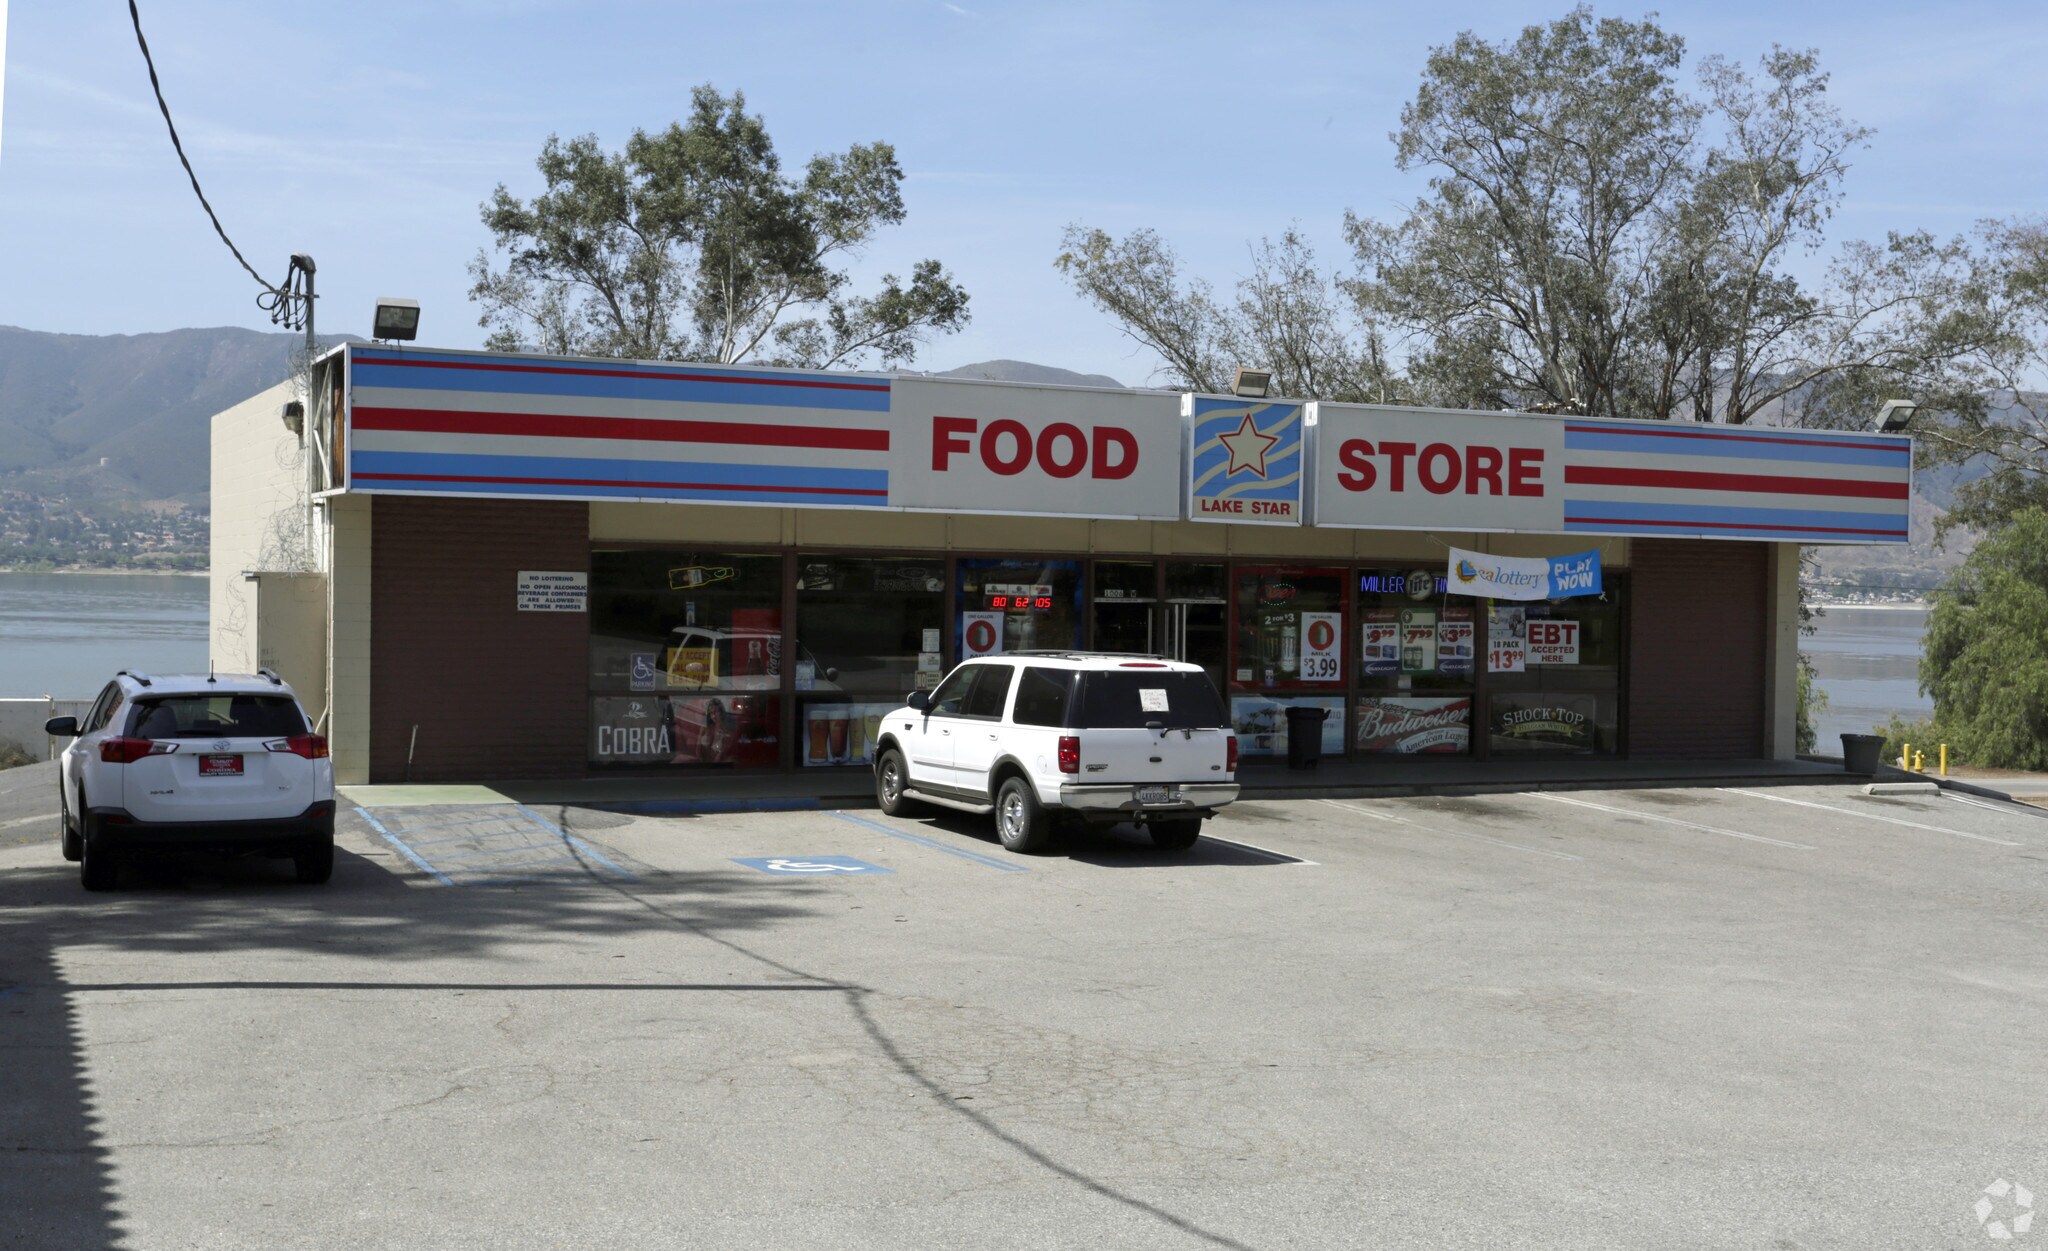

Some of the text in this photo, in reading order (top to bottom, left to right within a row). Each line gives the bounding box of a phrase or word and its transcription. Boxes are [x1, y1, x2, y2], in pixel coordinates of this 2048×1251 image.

[932, 417, 1139, 480] FOOD
[1337, 438, 1544, 497] STORE
[1201, 498, 1291, 516] LAKE STAR
[1553, 556, 1593, 577] PLAY
[1360, 575, 1405, 593] MILLER
[1407, 577, 1430, 595] Lite
[1555, 571, 1593, 591] NOW
[992, 597, 1051, 608] 80 62 105
[1264, 615, 1272, 625] 2
[1284, 613, 1295, 622] $3
[1528, 624, 1577, 645] EBT
[1303, 658, 1337, 677] $3.99
[1359, 707, 1470, 741] Budweiser
[1503, 707, 1584, 726] SHOCK TOP
[1547, 723, 1567, 731] WHITE
[598, 724, 671, 755] COBRA
[1405, 733, 1443, 752] American
[1444, 731, 1468, 742] Lager
